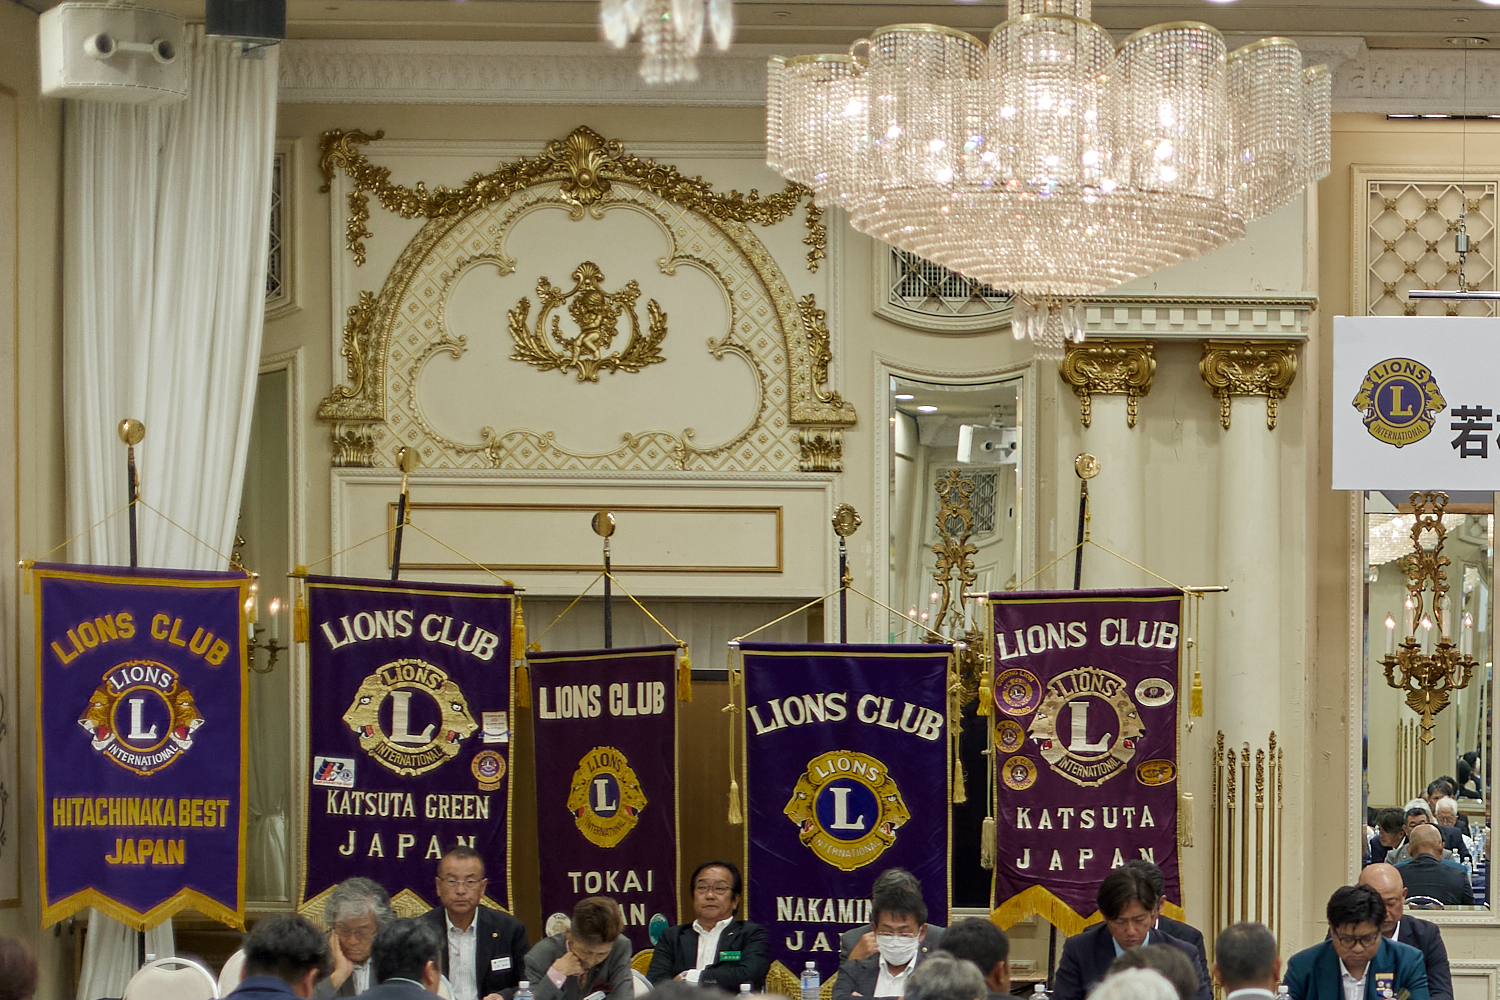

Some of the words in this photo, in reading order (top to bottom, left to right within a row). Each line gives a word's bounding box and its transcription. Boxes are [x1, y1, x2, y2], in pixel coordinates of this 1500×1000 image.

[1373, 361, 1427, 380] LIONS
[1389, 385, 1413, 416] L
[1373, 423, 1427, 441] INTERNATIONAL
[50, 611, 137, 665] LIONS
[150, 612, 230, 666] CLUB
[319, 609, 414, 650] LIONS
[420, 613, 500, 662] CLUB
[996, 620, 1087, 661] LIONS
[1100, 617, 1179, 650] CLUB
[109, 666, 173, 690] LIONS
[381, 666, 441, 688] LIONS
[1056, 672, 1119, 697] LIONS
[539, 683, 601, 720] LIONS
[608, 681, 666, 716] CLUB
[127, 698, 158, 740] L
[389, 690, 436, 744] L
[748, 691, 847, 736] LIONS
[857, 694, 944, 741] CLUB
[1068, 701, 1112, 751] L
[107, 742, 180, 767] INTERNATIONAL
[375, 741, 444, 767] INTERNATIONAL
[586, 753, 624, 774] LIONS
[814, 757, 880, 782] LIONS
[1057, 757, 1120, 779] INTERNATIONAL
[326, 789, 417, 819] KATSUTA
[425, 794, 491, 820] GREEN
[594, 778, 617, 812] L
[52, 797, 177, 828] HITACHINAKA
[178, 799, 229, 828] BEST
[829, 787, 865, 830] L
[1016, 805, 1155, 830] KATSUTA
[584, 818, 628, 838] INTERNATIONAL
[105, 838, 185, 866] JAPAN
[813, 835, 882, 860] INTERNATIONAL
[1016, 847, 1154, 871] JAPAN
[568, 869, 653, 894] TOKAI
